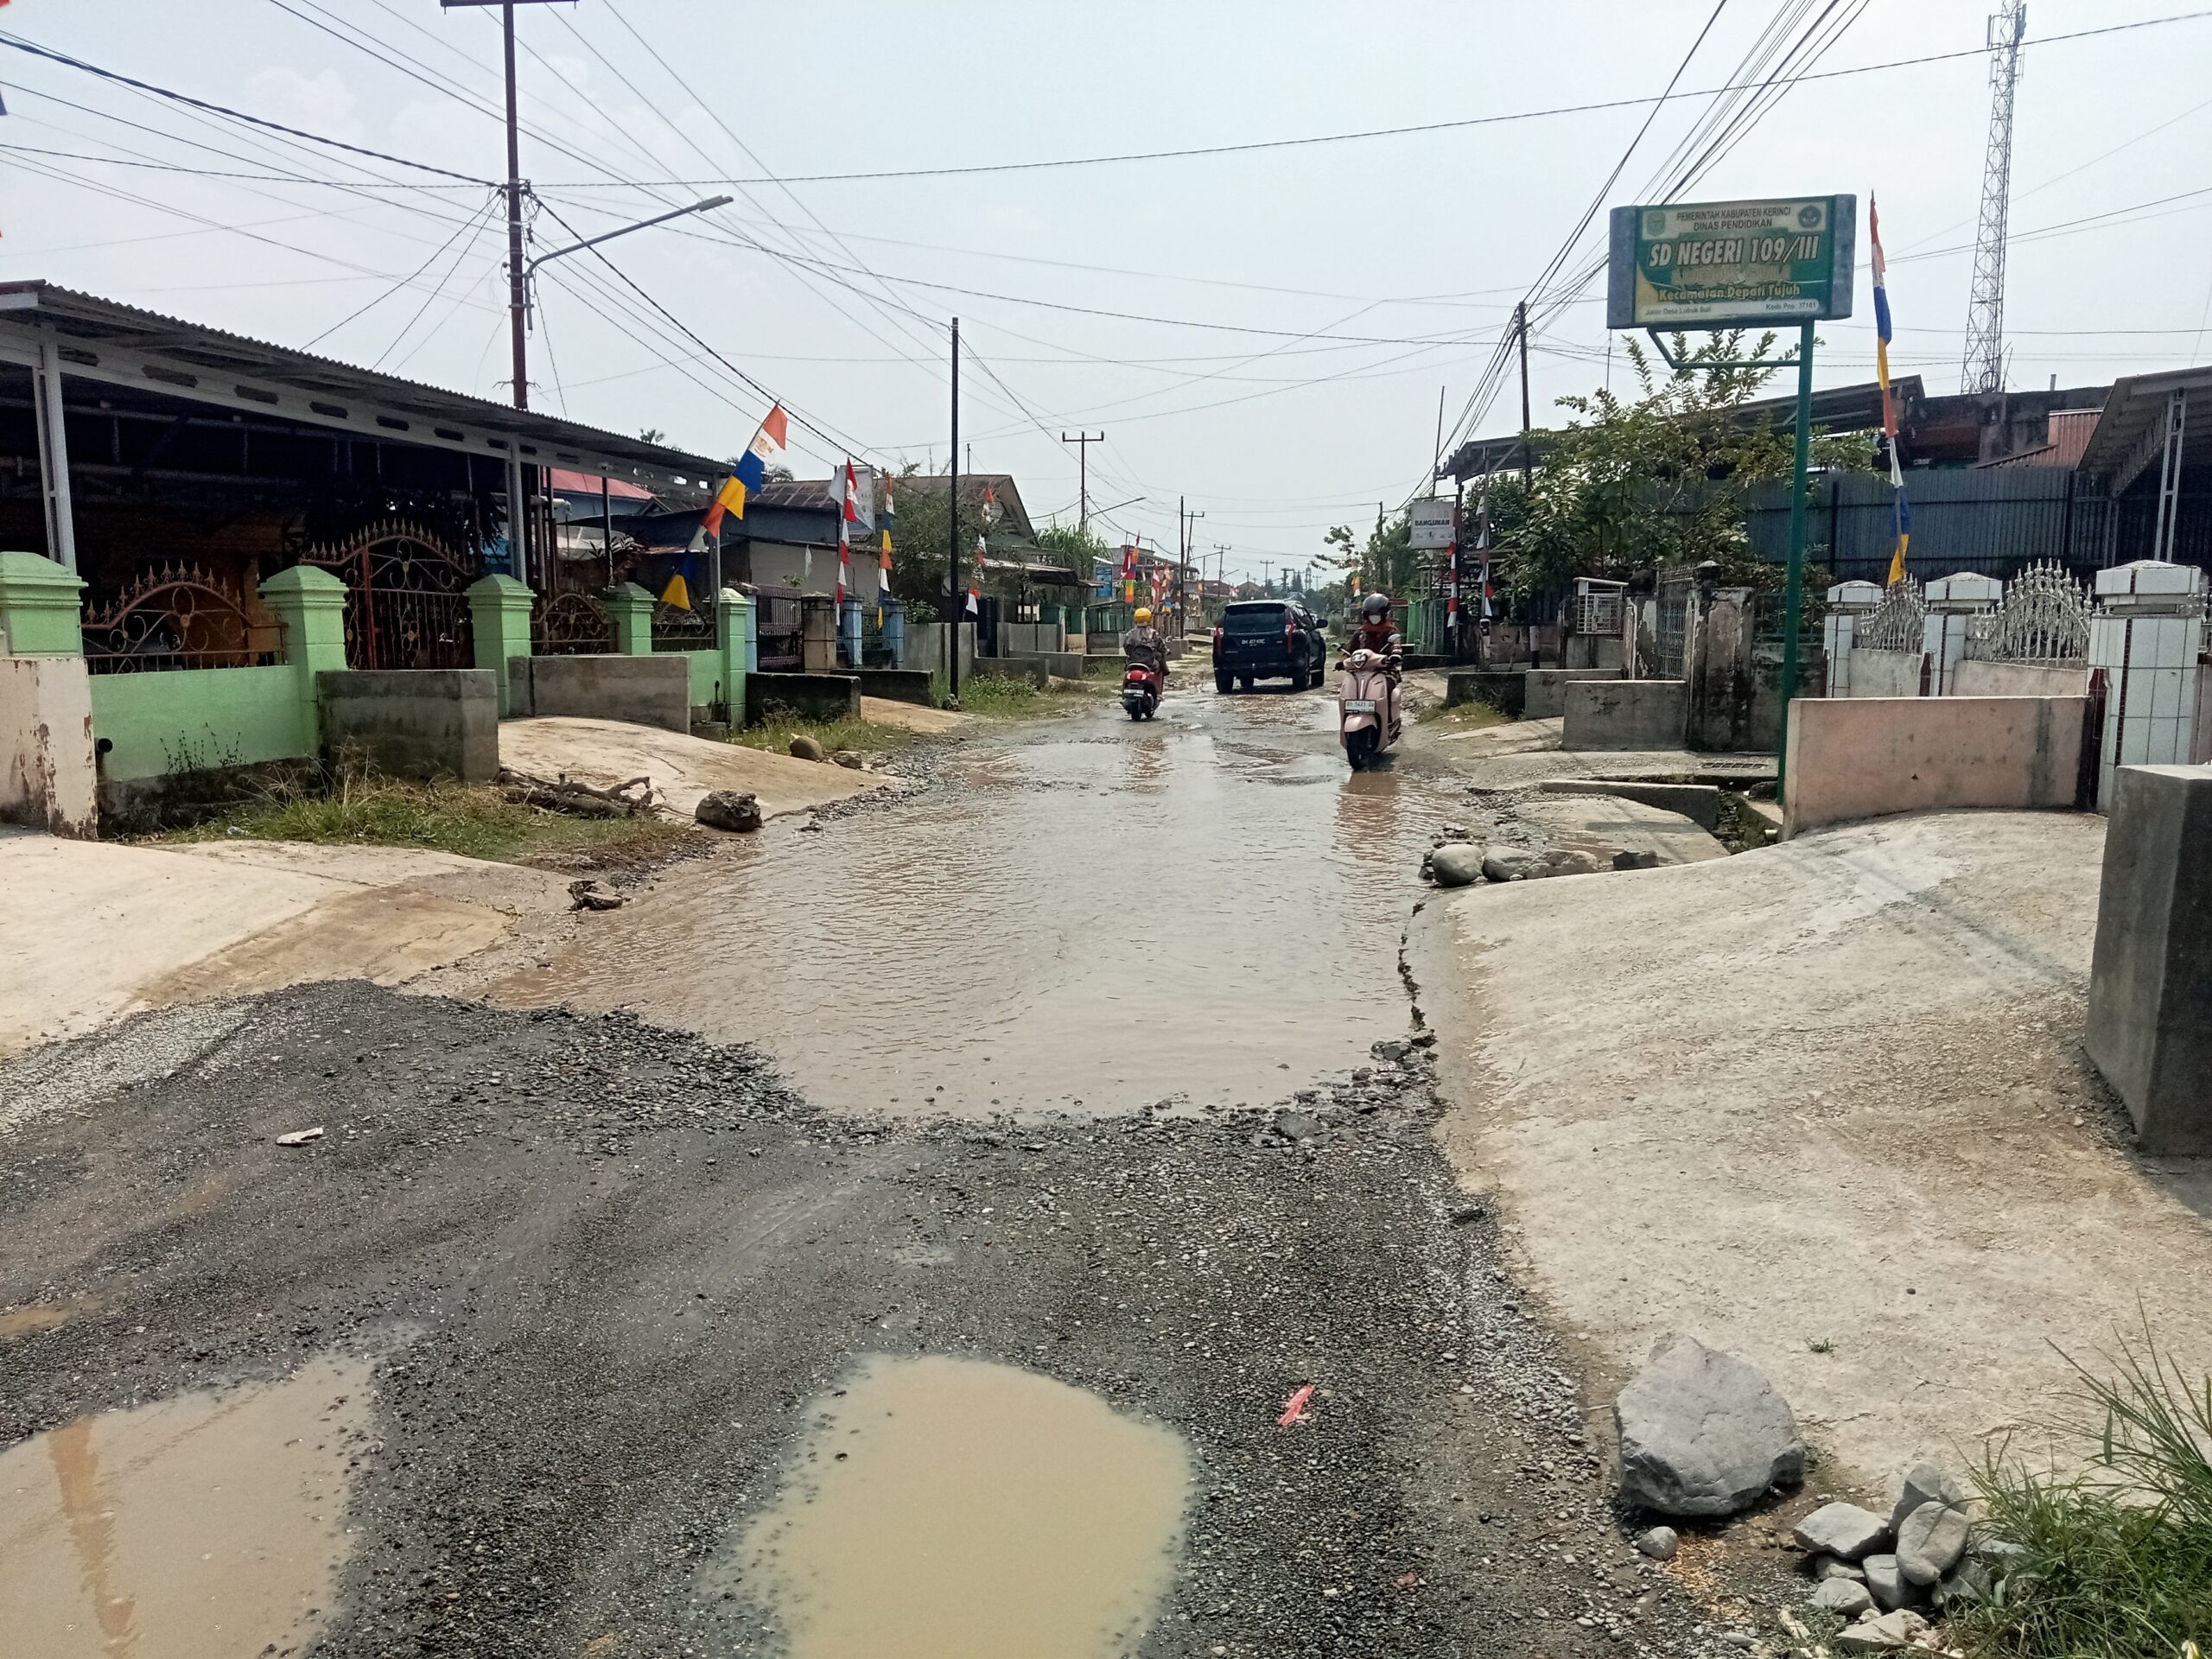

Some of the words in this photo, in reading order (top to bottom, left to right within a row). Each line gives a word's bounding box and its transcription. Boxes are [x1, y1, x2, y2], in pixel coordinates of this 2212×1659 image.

[1676, 210, 1720, 221] PEMERINTAH
[1721, 208, 1762, 219] KABUPATEN
[1763, 207, 1791, 217] KERINCI
[1694, 220, 1719, 232] DINAS
[1720, 218, 1773, 230] PENDIDIKAN
[1649, 242, 1673, 268] SD
[1676, 238, 1745, 267] NEGERI
[1750, 233, 1821, 264] 109/III
[1657, 285, 1725, 302] Kecamatan
[1726, 283, 1766, 301] Depati
[1768, 282, 1801, 298] Tujuh
